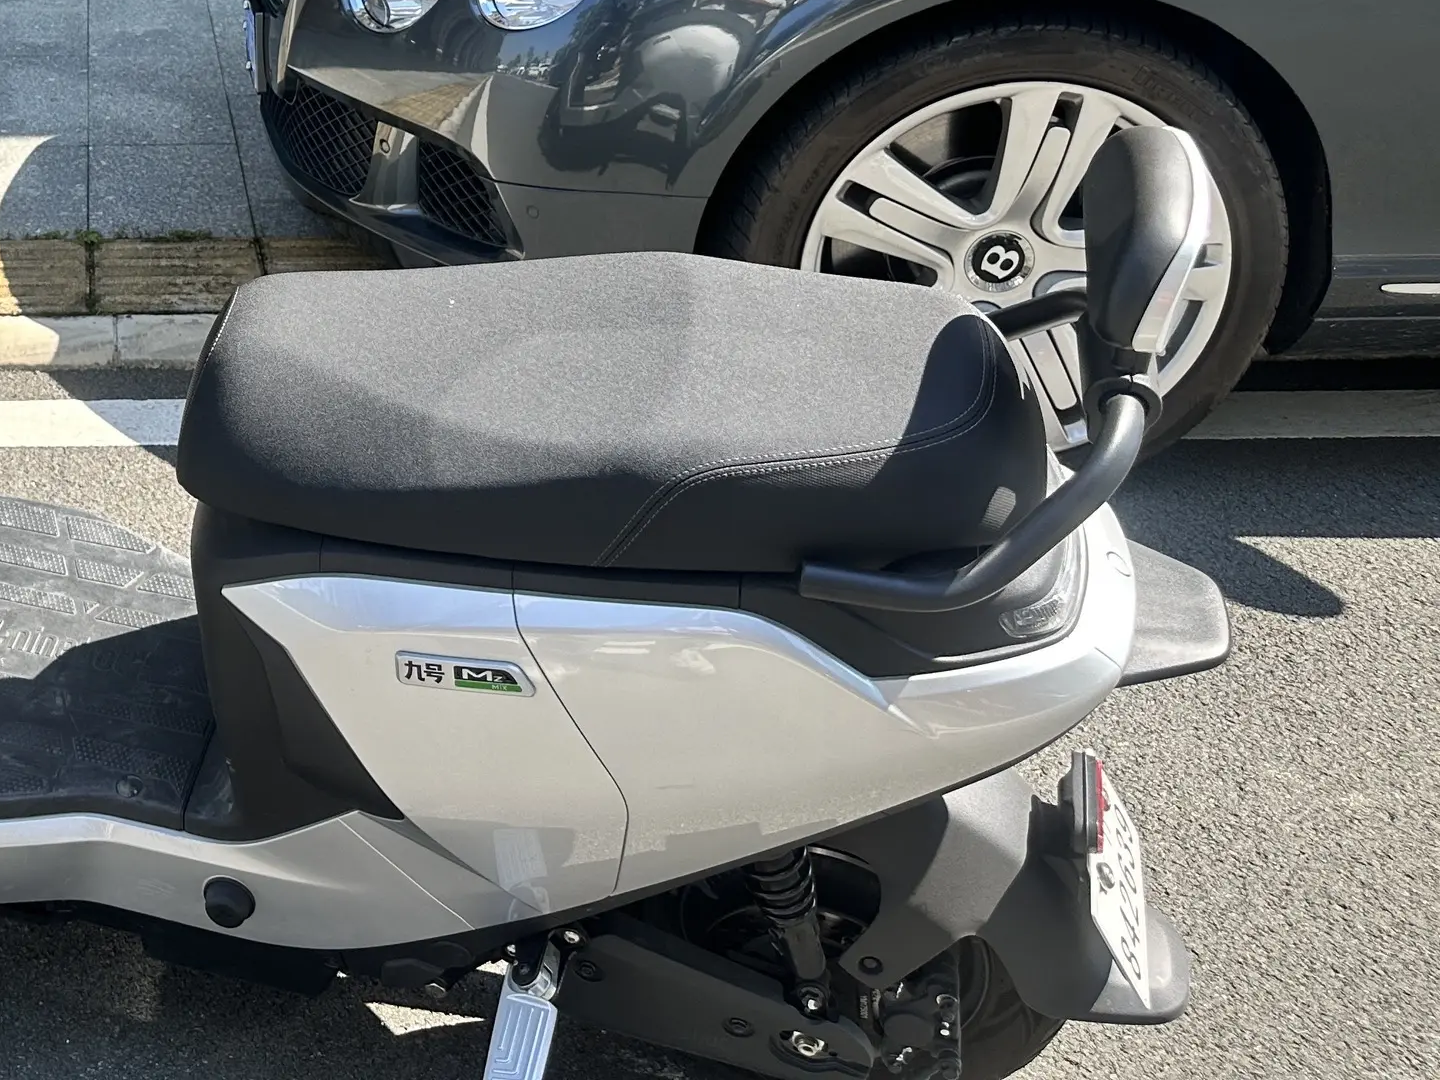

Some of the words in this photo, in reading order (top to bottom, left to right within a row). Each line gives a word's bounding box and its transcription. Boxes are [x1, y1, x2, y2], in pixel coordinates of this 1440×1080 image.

[981, 245, 1020, 279] B
[404, 660, 445, 684] 九号
[1112, 803, 1142, 981] 842639
